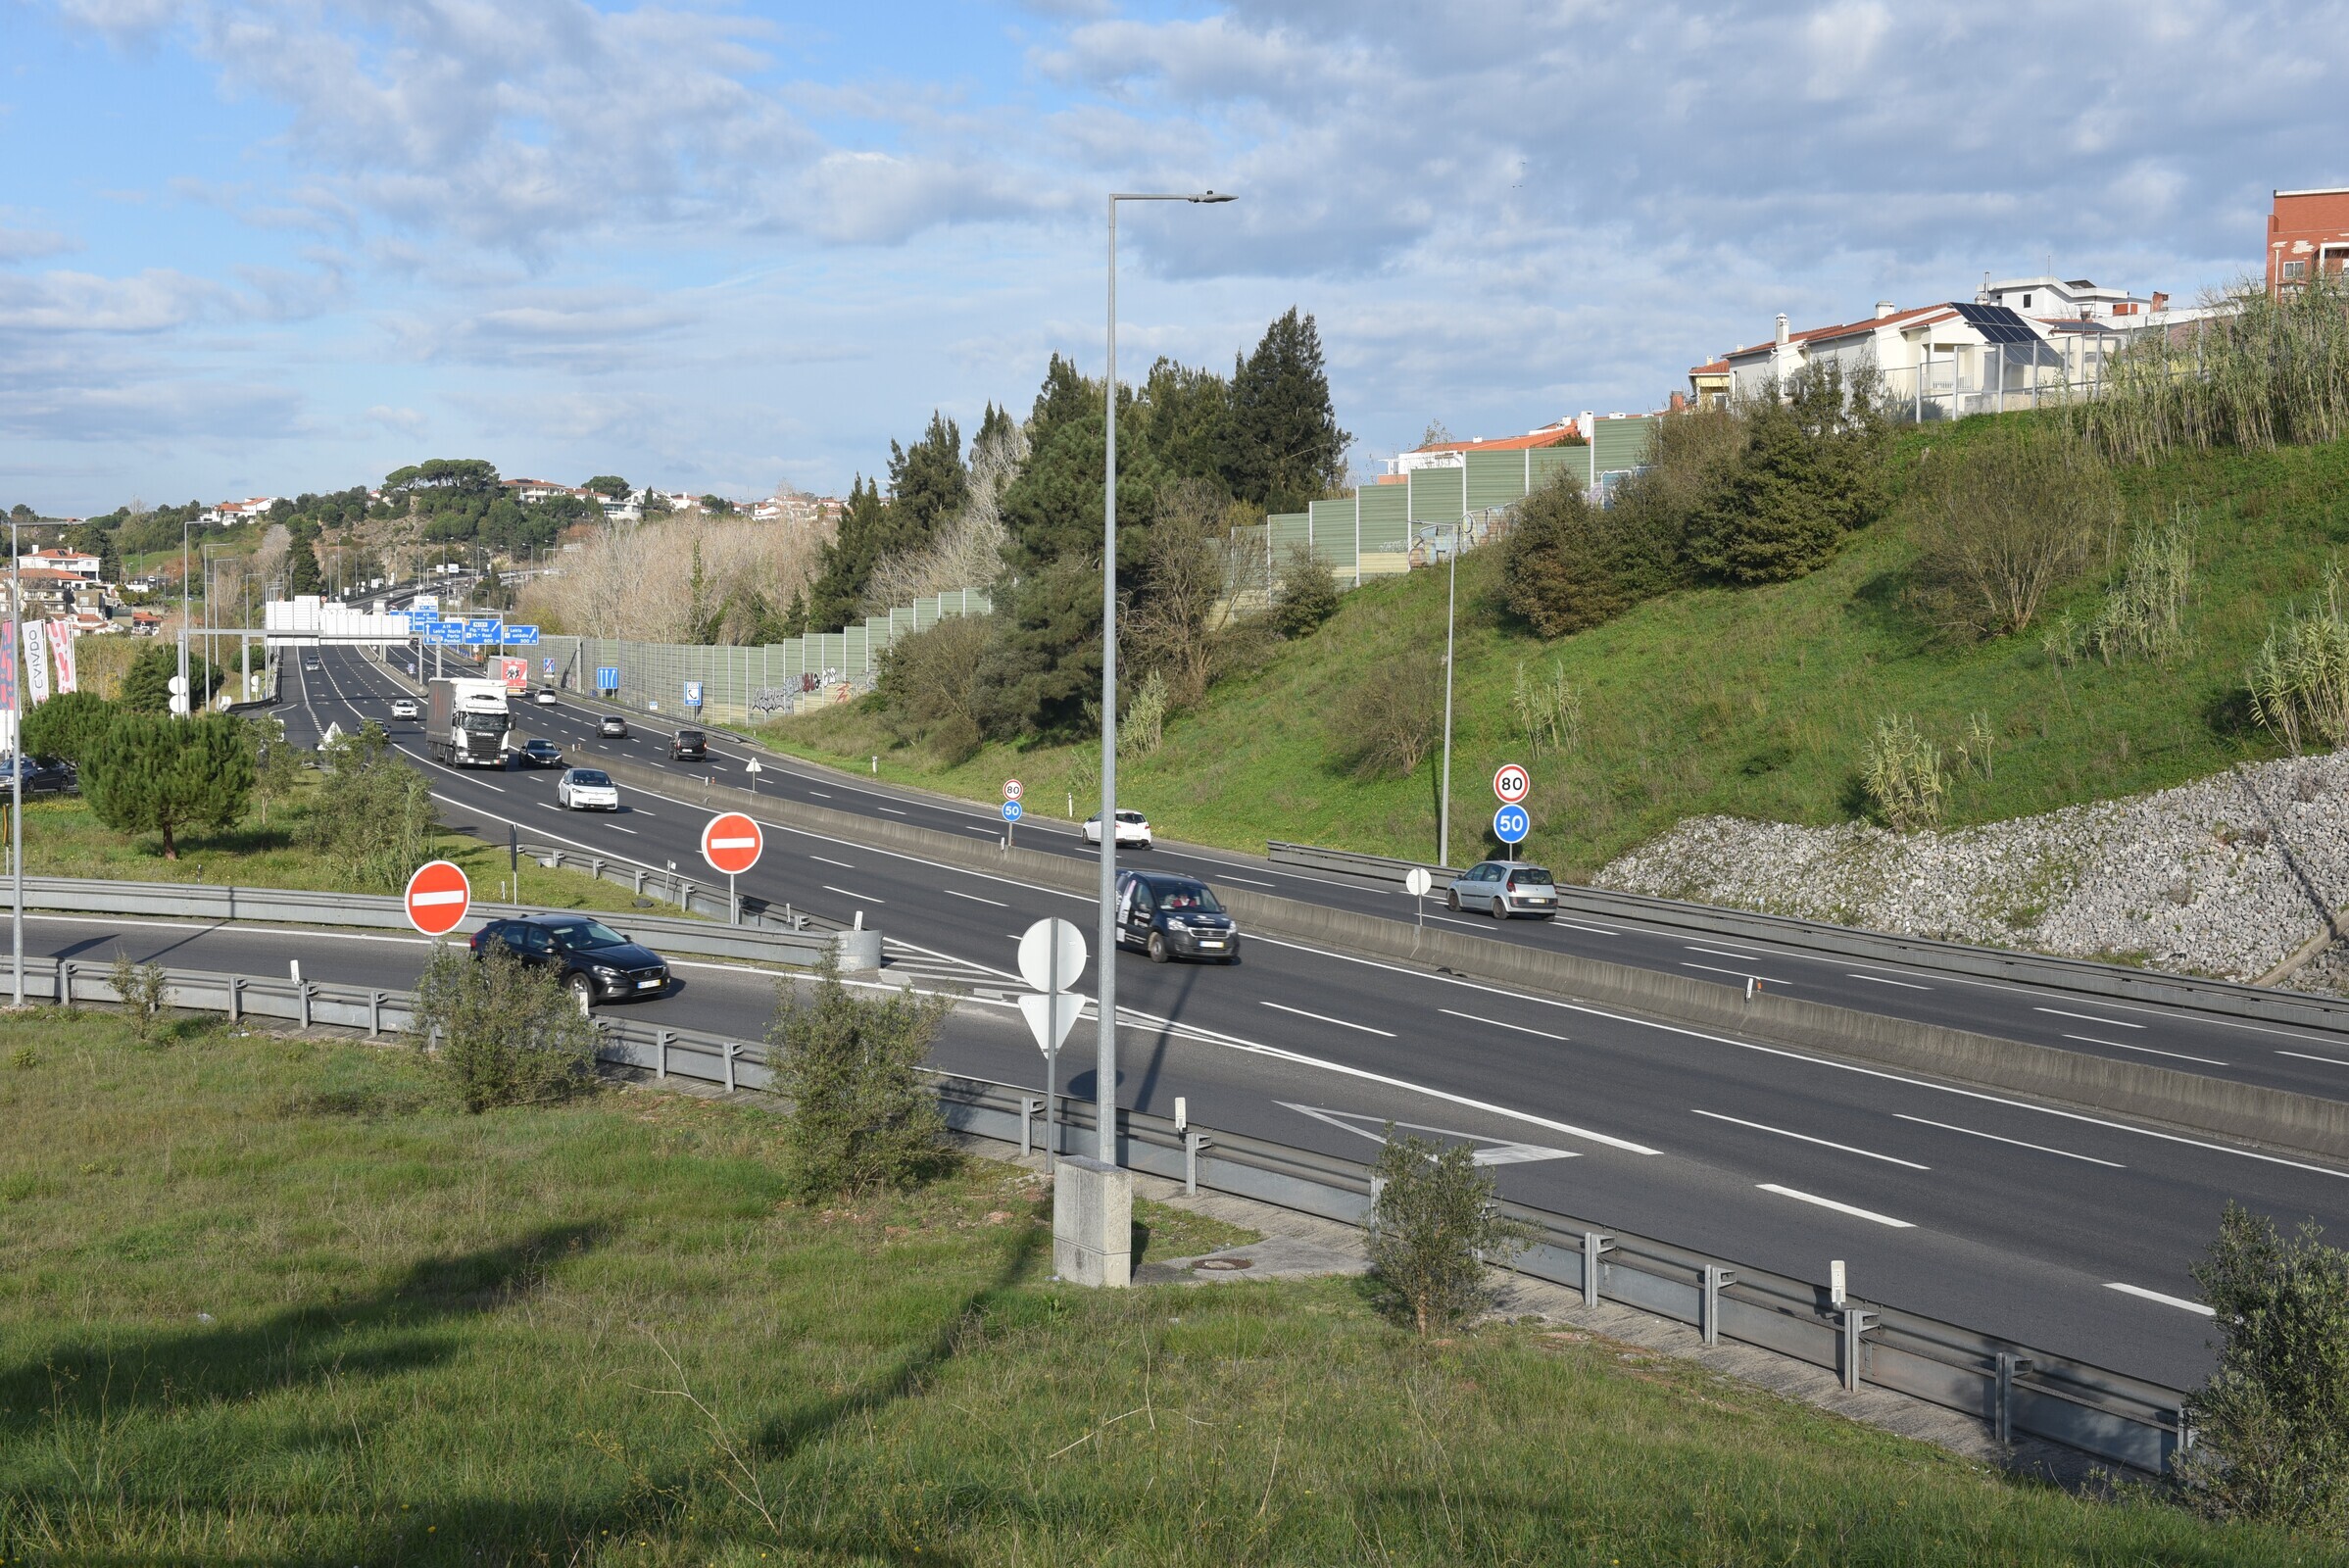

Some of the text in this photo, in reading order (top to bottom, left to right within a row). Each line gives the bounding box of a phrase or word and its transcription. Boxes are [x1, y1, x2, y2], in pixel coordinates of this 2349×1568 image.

[1006, 785, 1020, 795] 80
[1501, 777, 1523, 791] 80
[1004, 806, 1019, 816] 50
[1499, 815, 1524, 832] 50
